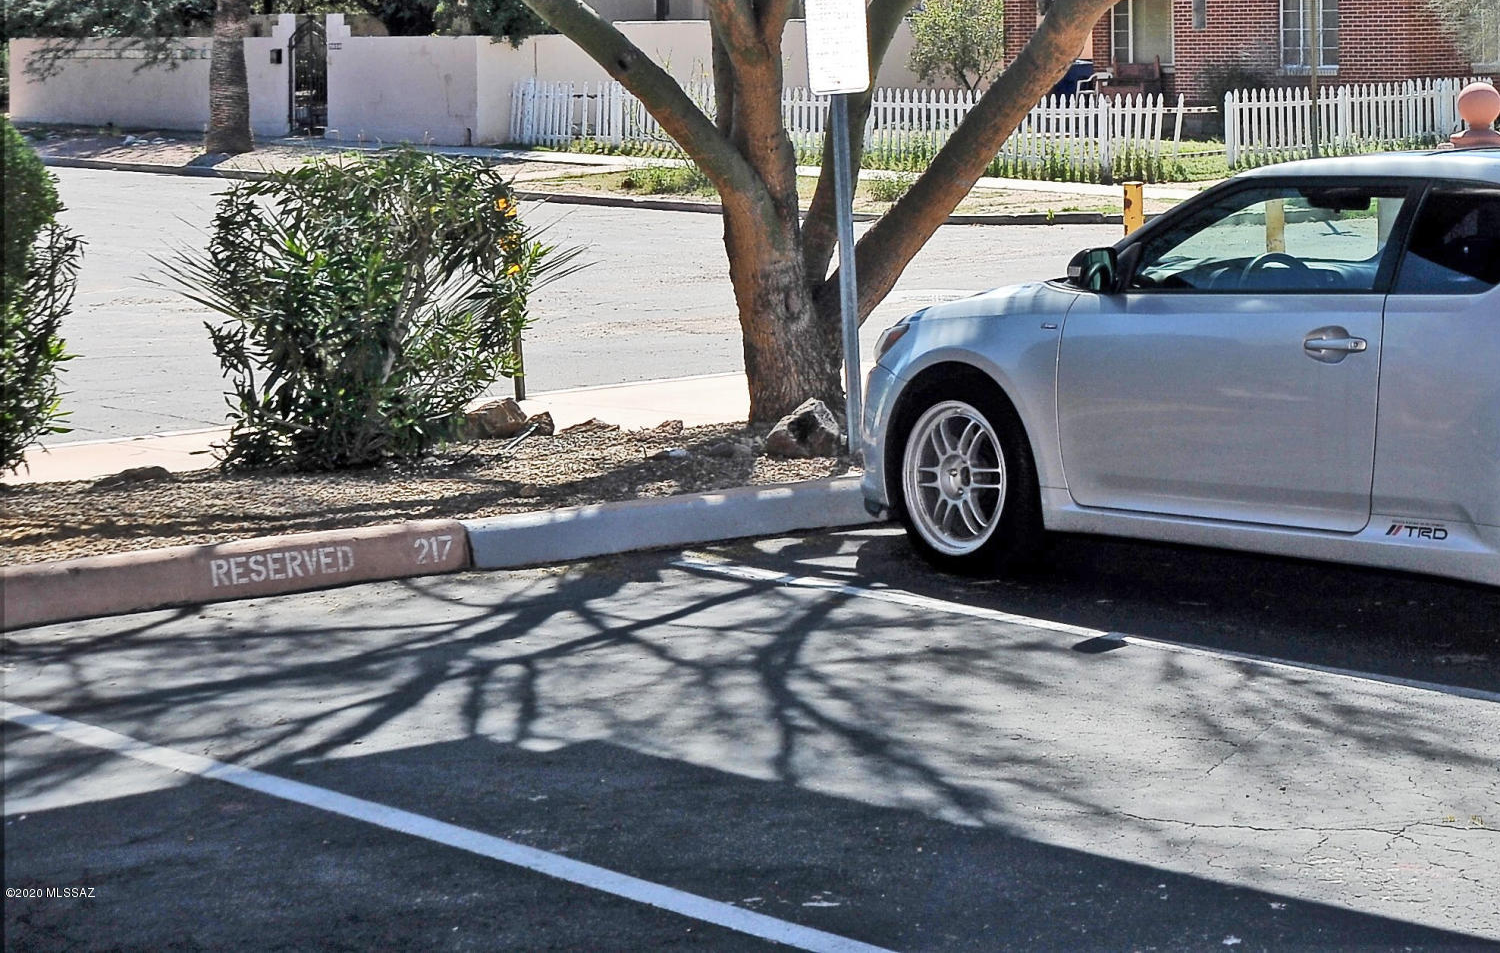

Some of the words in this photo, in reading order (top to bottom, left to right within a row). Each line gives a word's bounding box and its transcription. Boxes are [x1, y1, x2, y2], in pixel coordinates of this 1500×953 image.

[1404, 525, 1448, 540] TRD
[210, 545, 355, 587] RESERVED
[413, 535, 452, 565] 217
